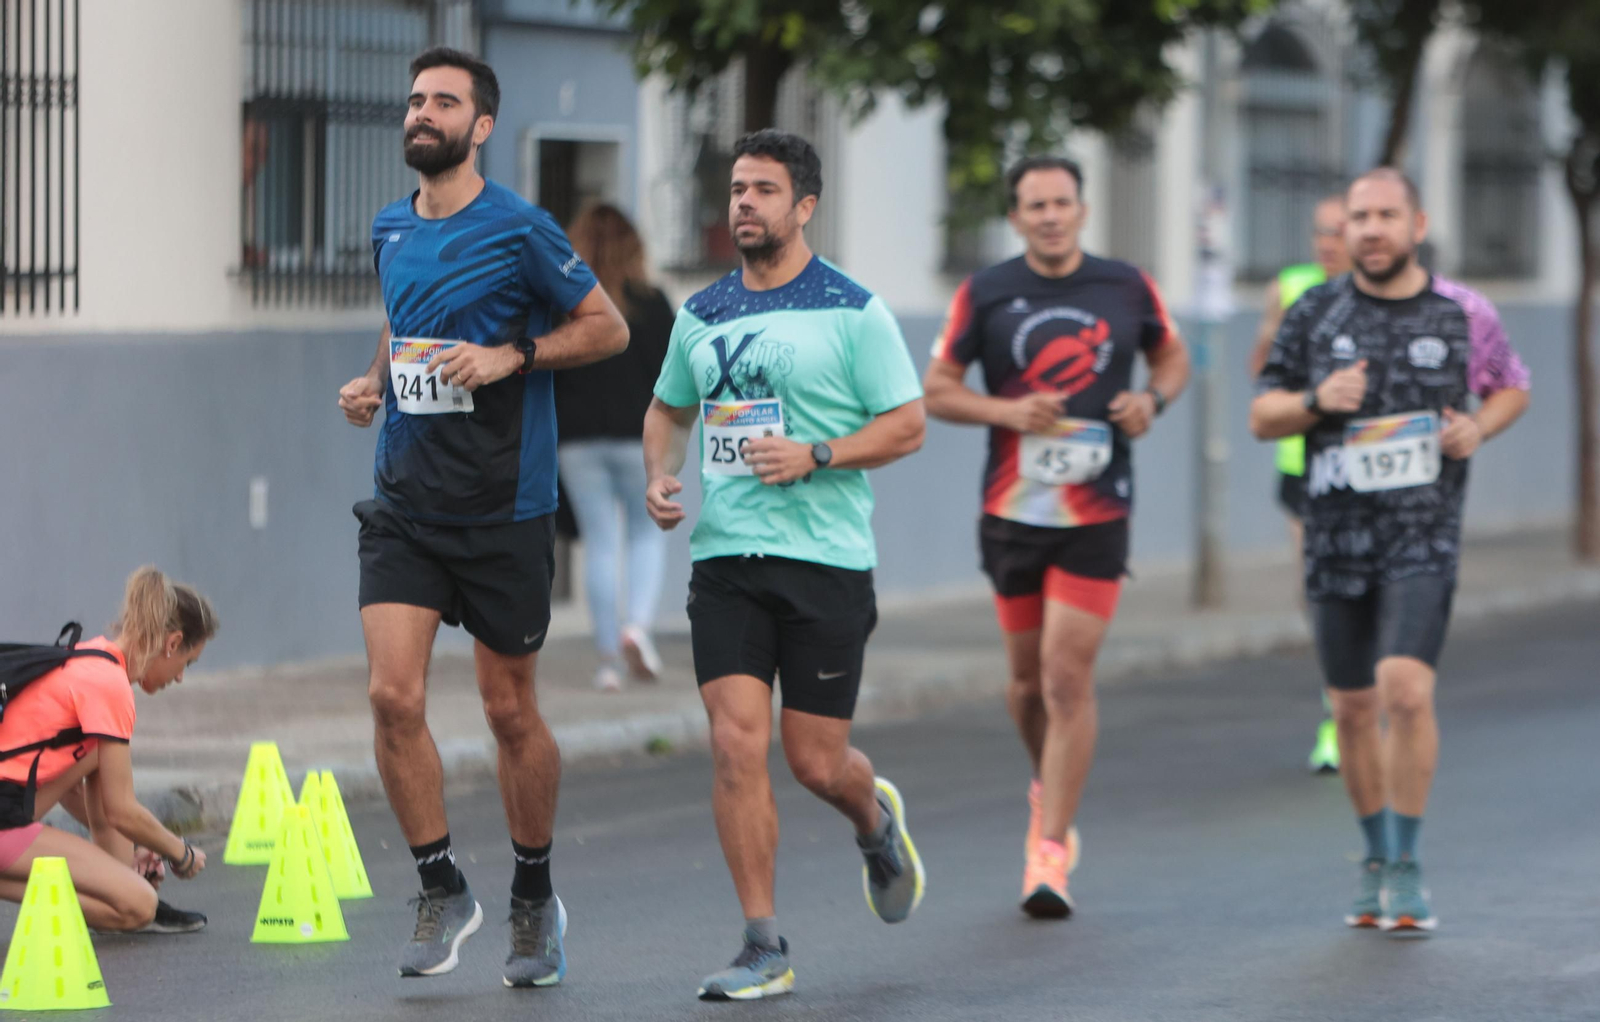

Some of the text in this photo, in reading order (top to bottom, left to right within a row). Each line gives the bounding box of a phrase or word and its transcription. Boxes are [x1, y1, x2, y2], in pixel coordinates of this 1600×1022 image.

[398, 373, 438, 401] 241
[732, 407, 773, 418] POPULAR
[1035, 447, 1071, 475] 45
[1360, 448, 1412, 479] 197
